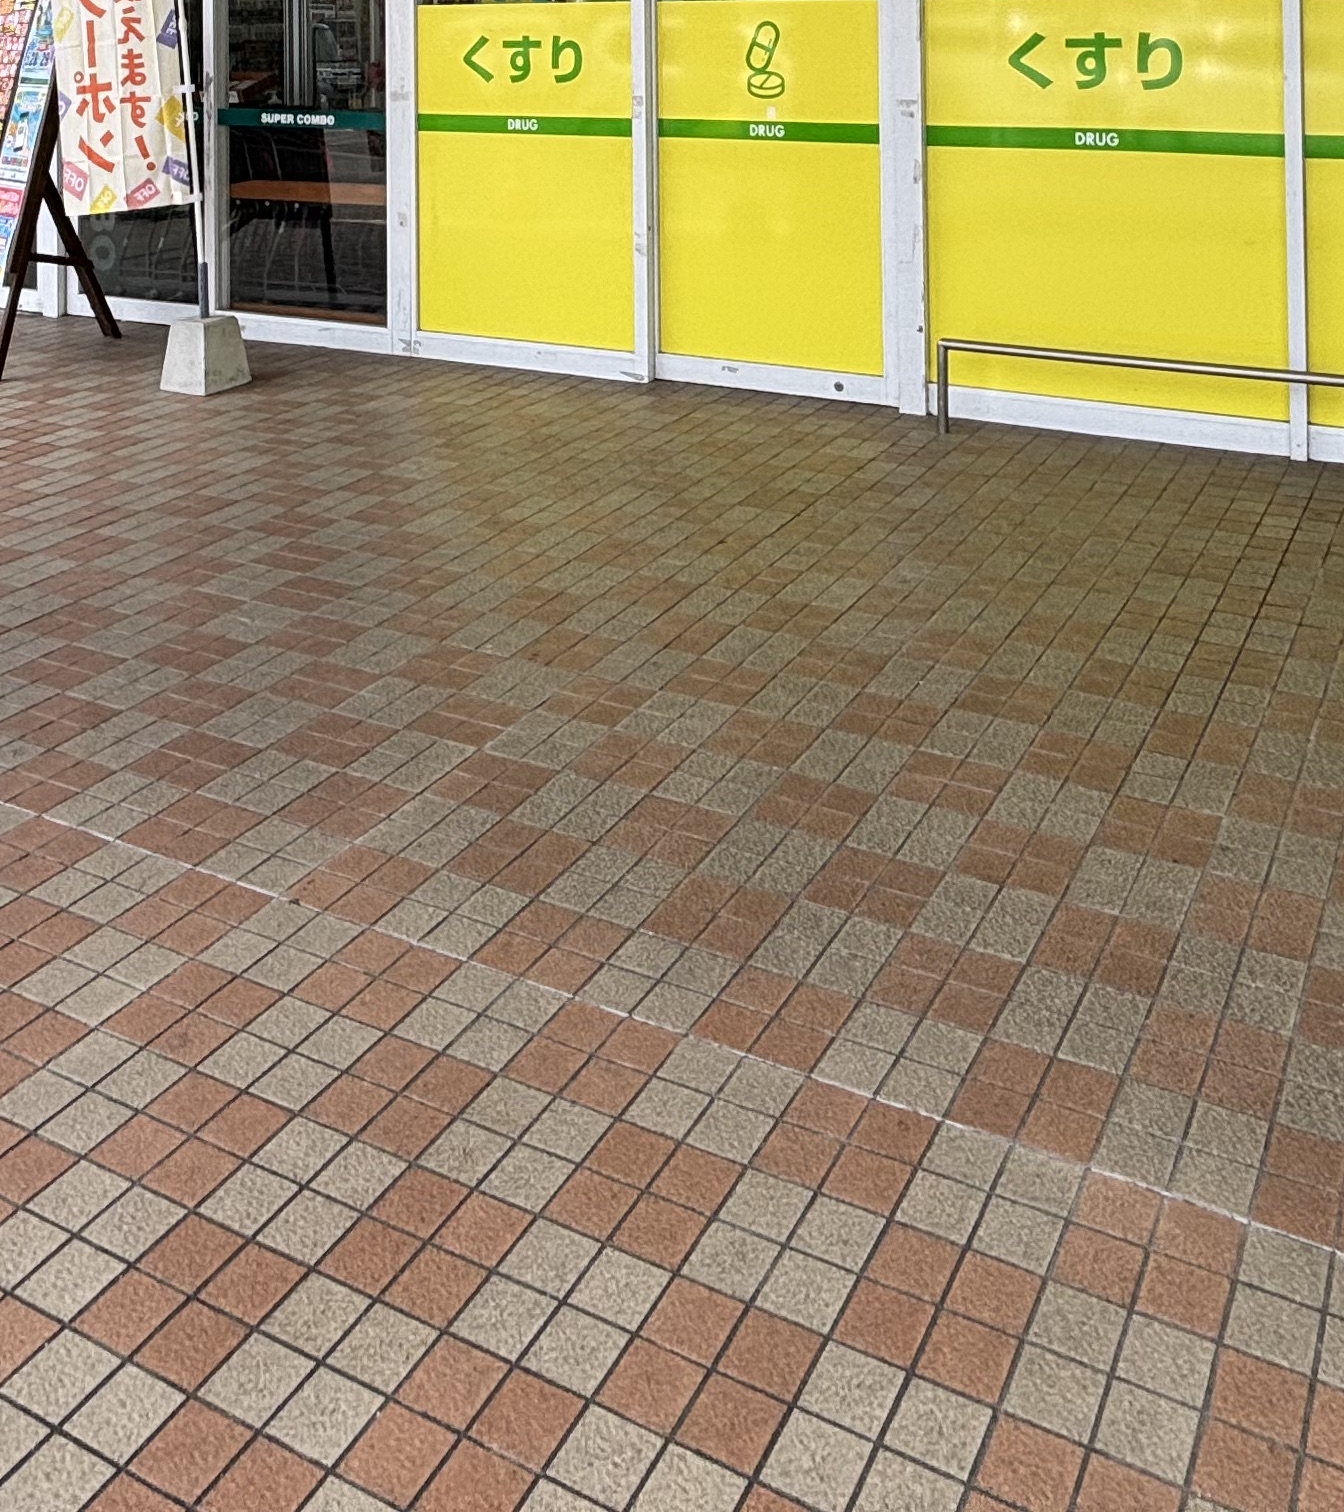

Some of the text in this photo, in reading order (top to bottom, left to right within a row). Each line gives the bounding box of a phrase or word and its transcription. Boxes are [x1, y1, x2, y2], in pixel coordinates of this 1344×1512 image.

[463, 35, 583, 84] くすり
[1008, 31, 1183, 90] くすり
[260, 112, 335, 126] SUPER COMBO
[507, 118, 539, 132] DRUG
[749, 124, 786, 139] DRUG
[1074, 132, 1120, 148] DRUG
